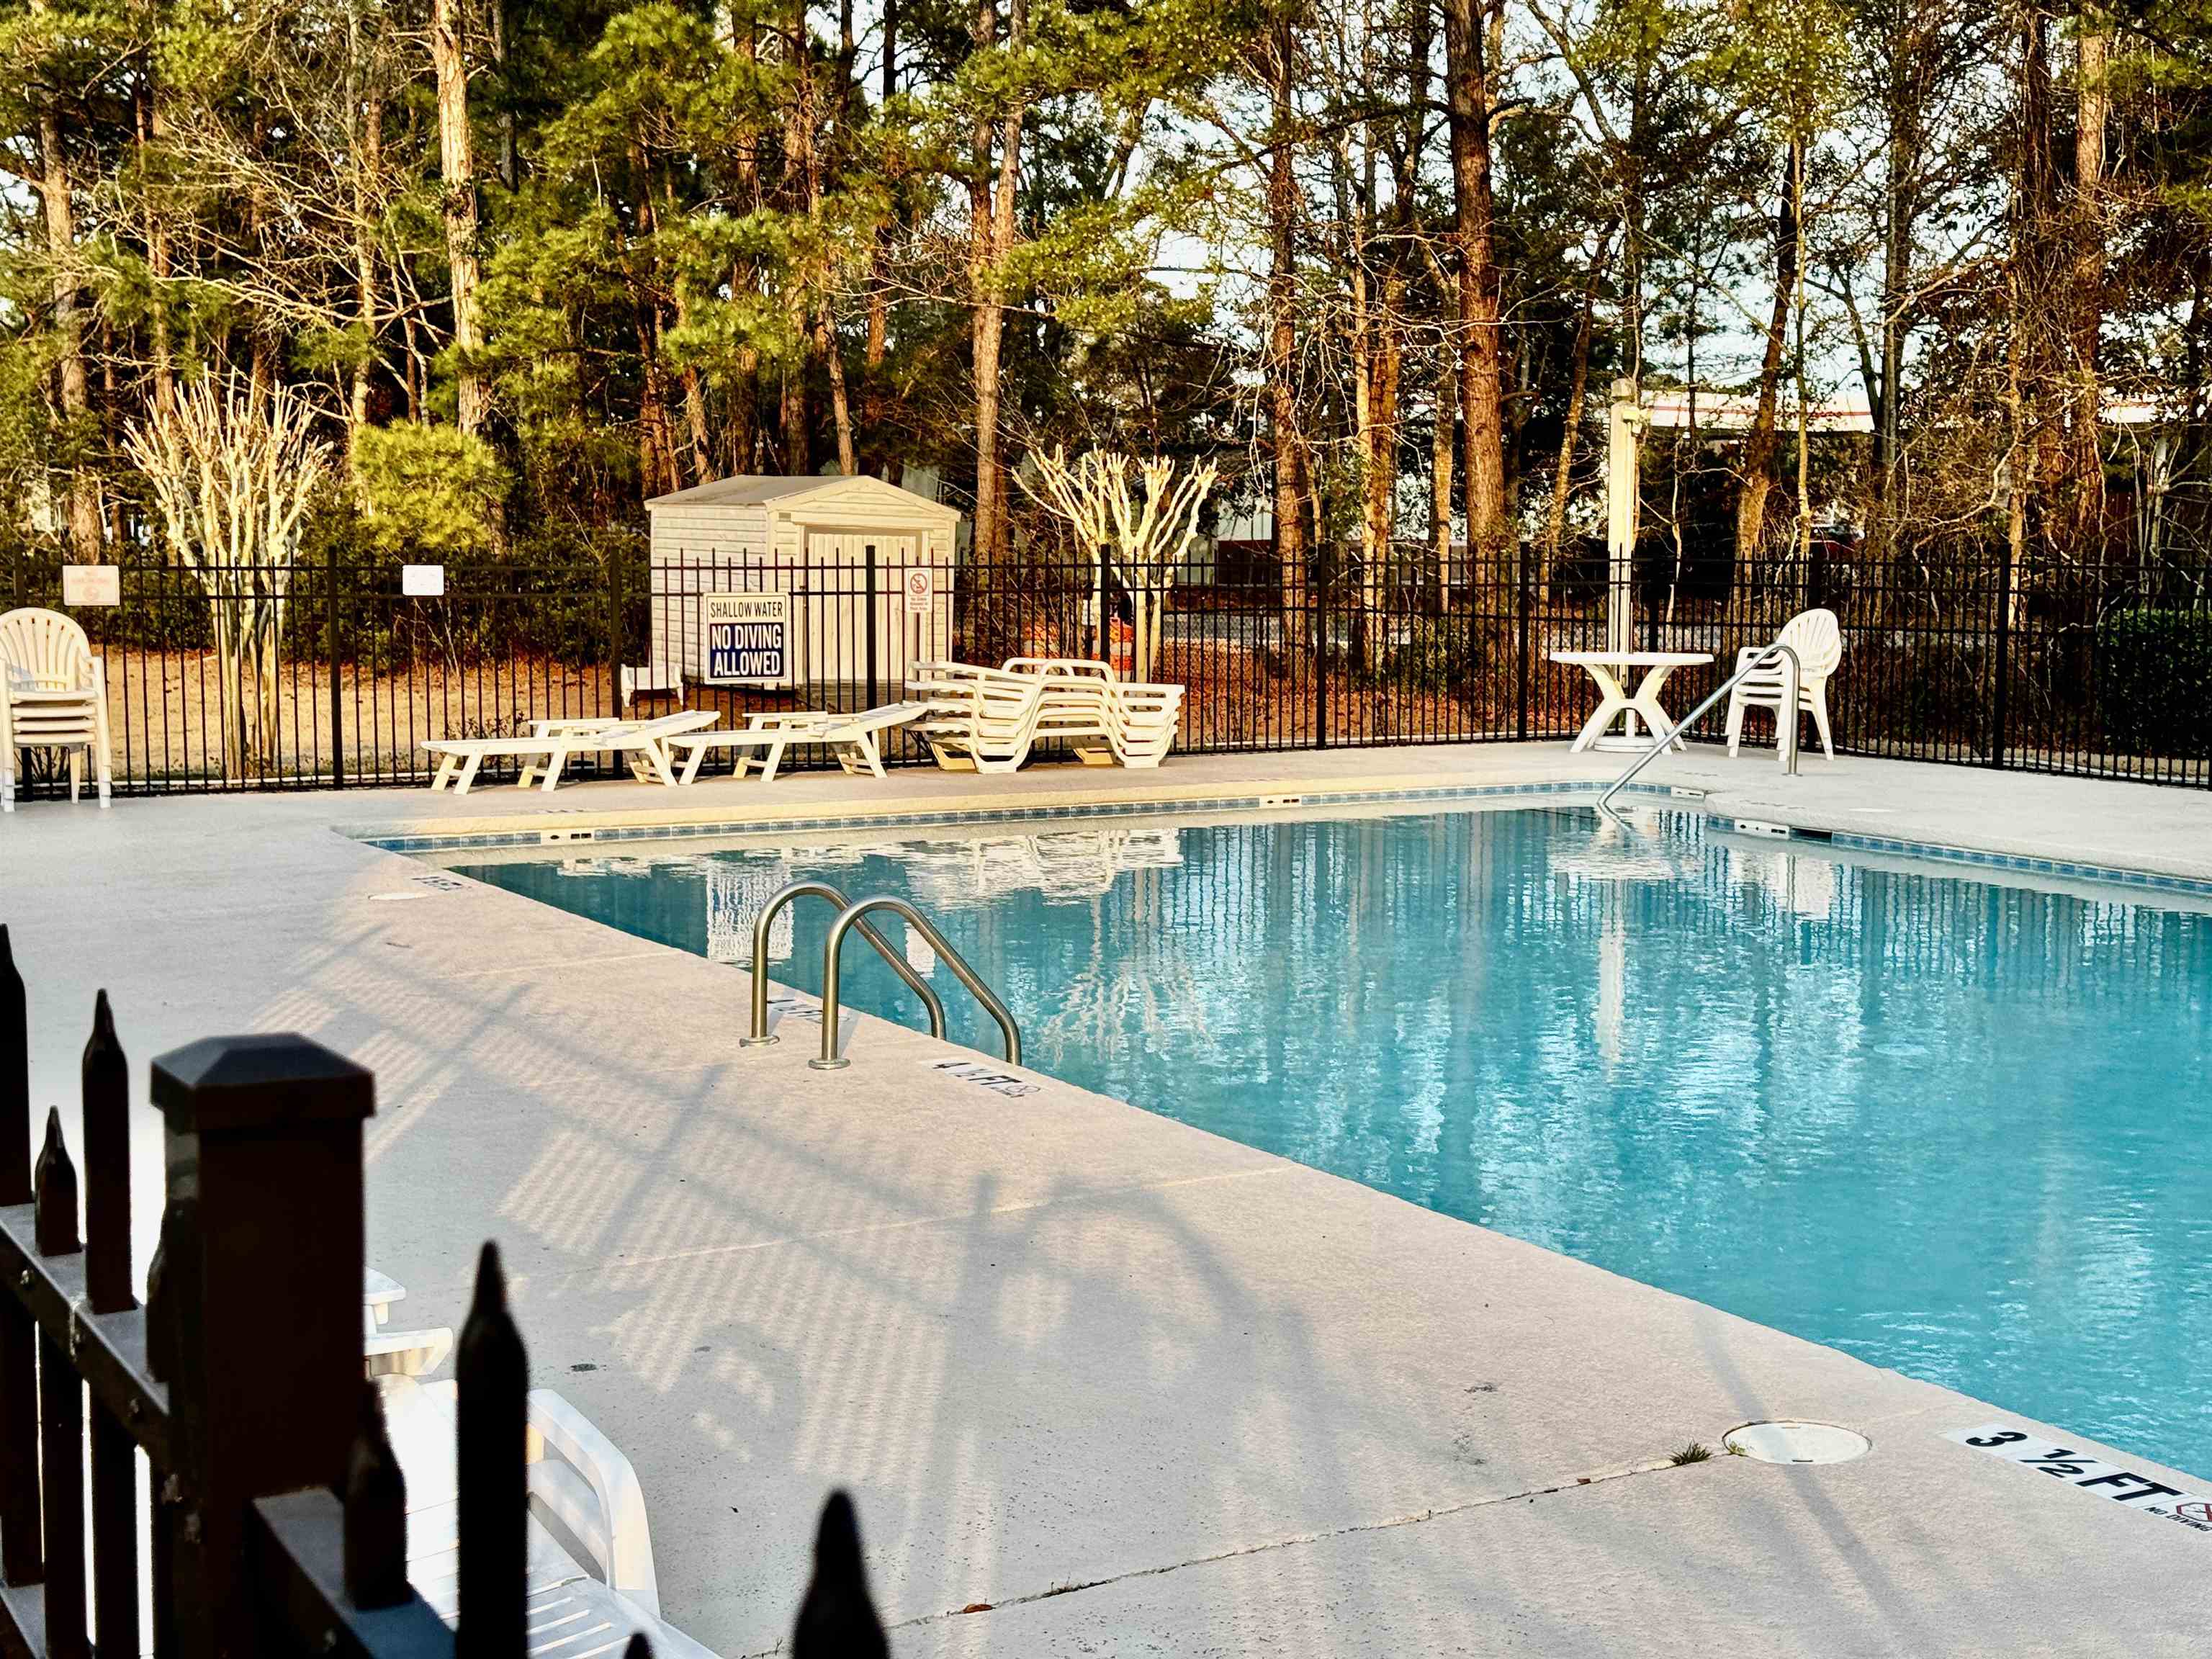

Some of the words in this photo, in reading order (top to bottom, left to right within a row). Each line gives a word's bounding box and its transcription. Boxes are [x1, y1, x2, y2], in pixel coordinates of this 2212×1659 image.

[710, 601, 752, 618] SHALLOW
[754, 601, 783, 617] WATER
[711, 624, 732, 650] NO
[734, 624, 782, 649] DIVING
[714, 650, 781, 677] ALLOWED
[1965, 1431, 2028, 1447] 3
[2075, 1471, 2185, 1501] FT
[2144, 1506, 2169, 1515] NO
[2165, 1514, 2212, 1532] DIVING
